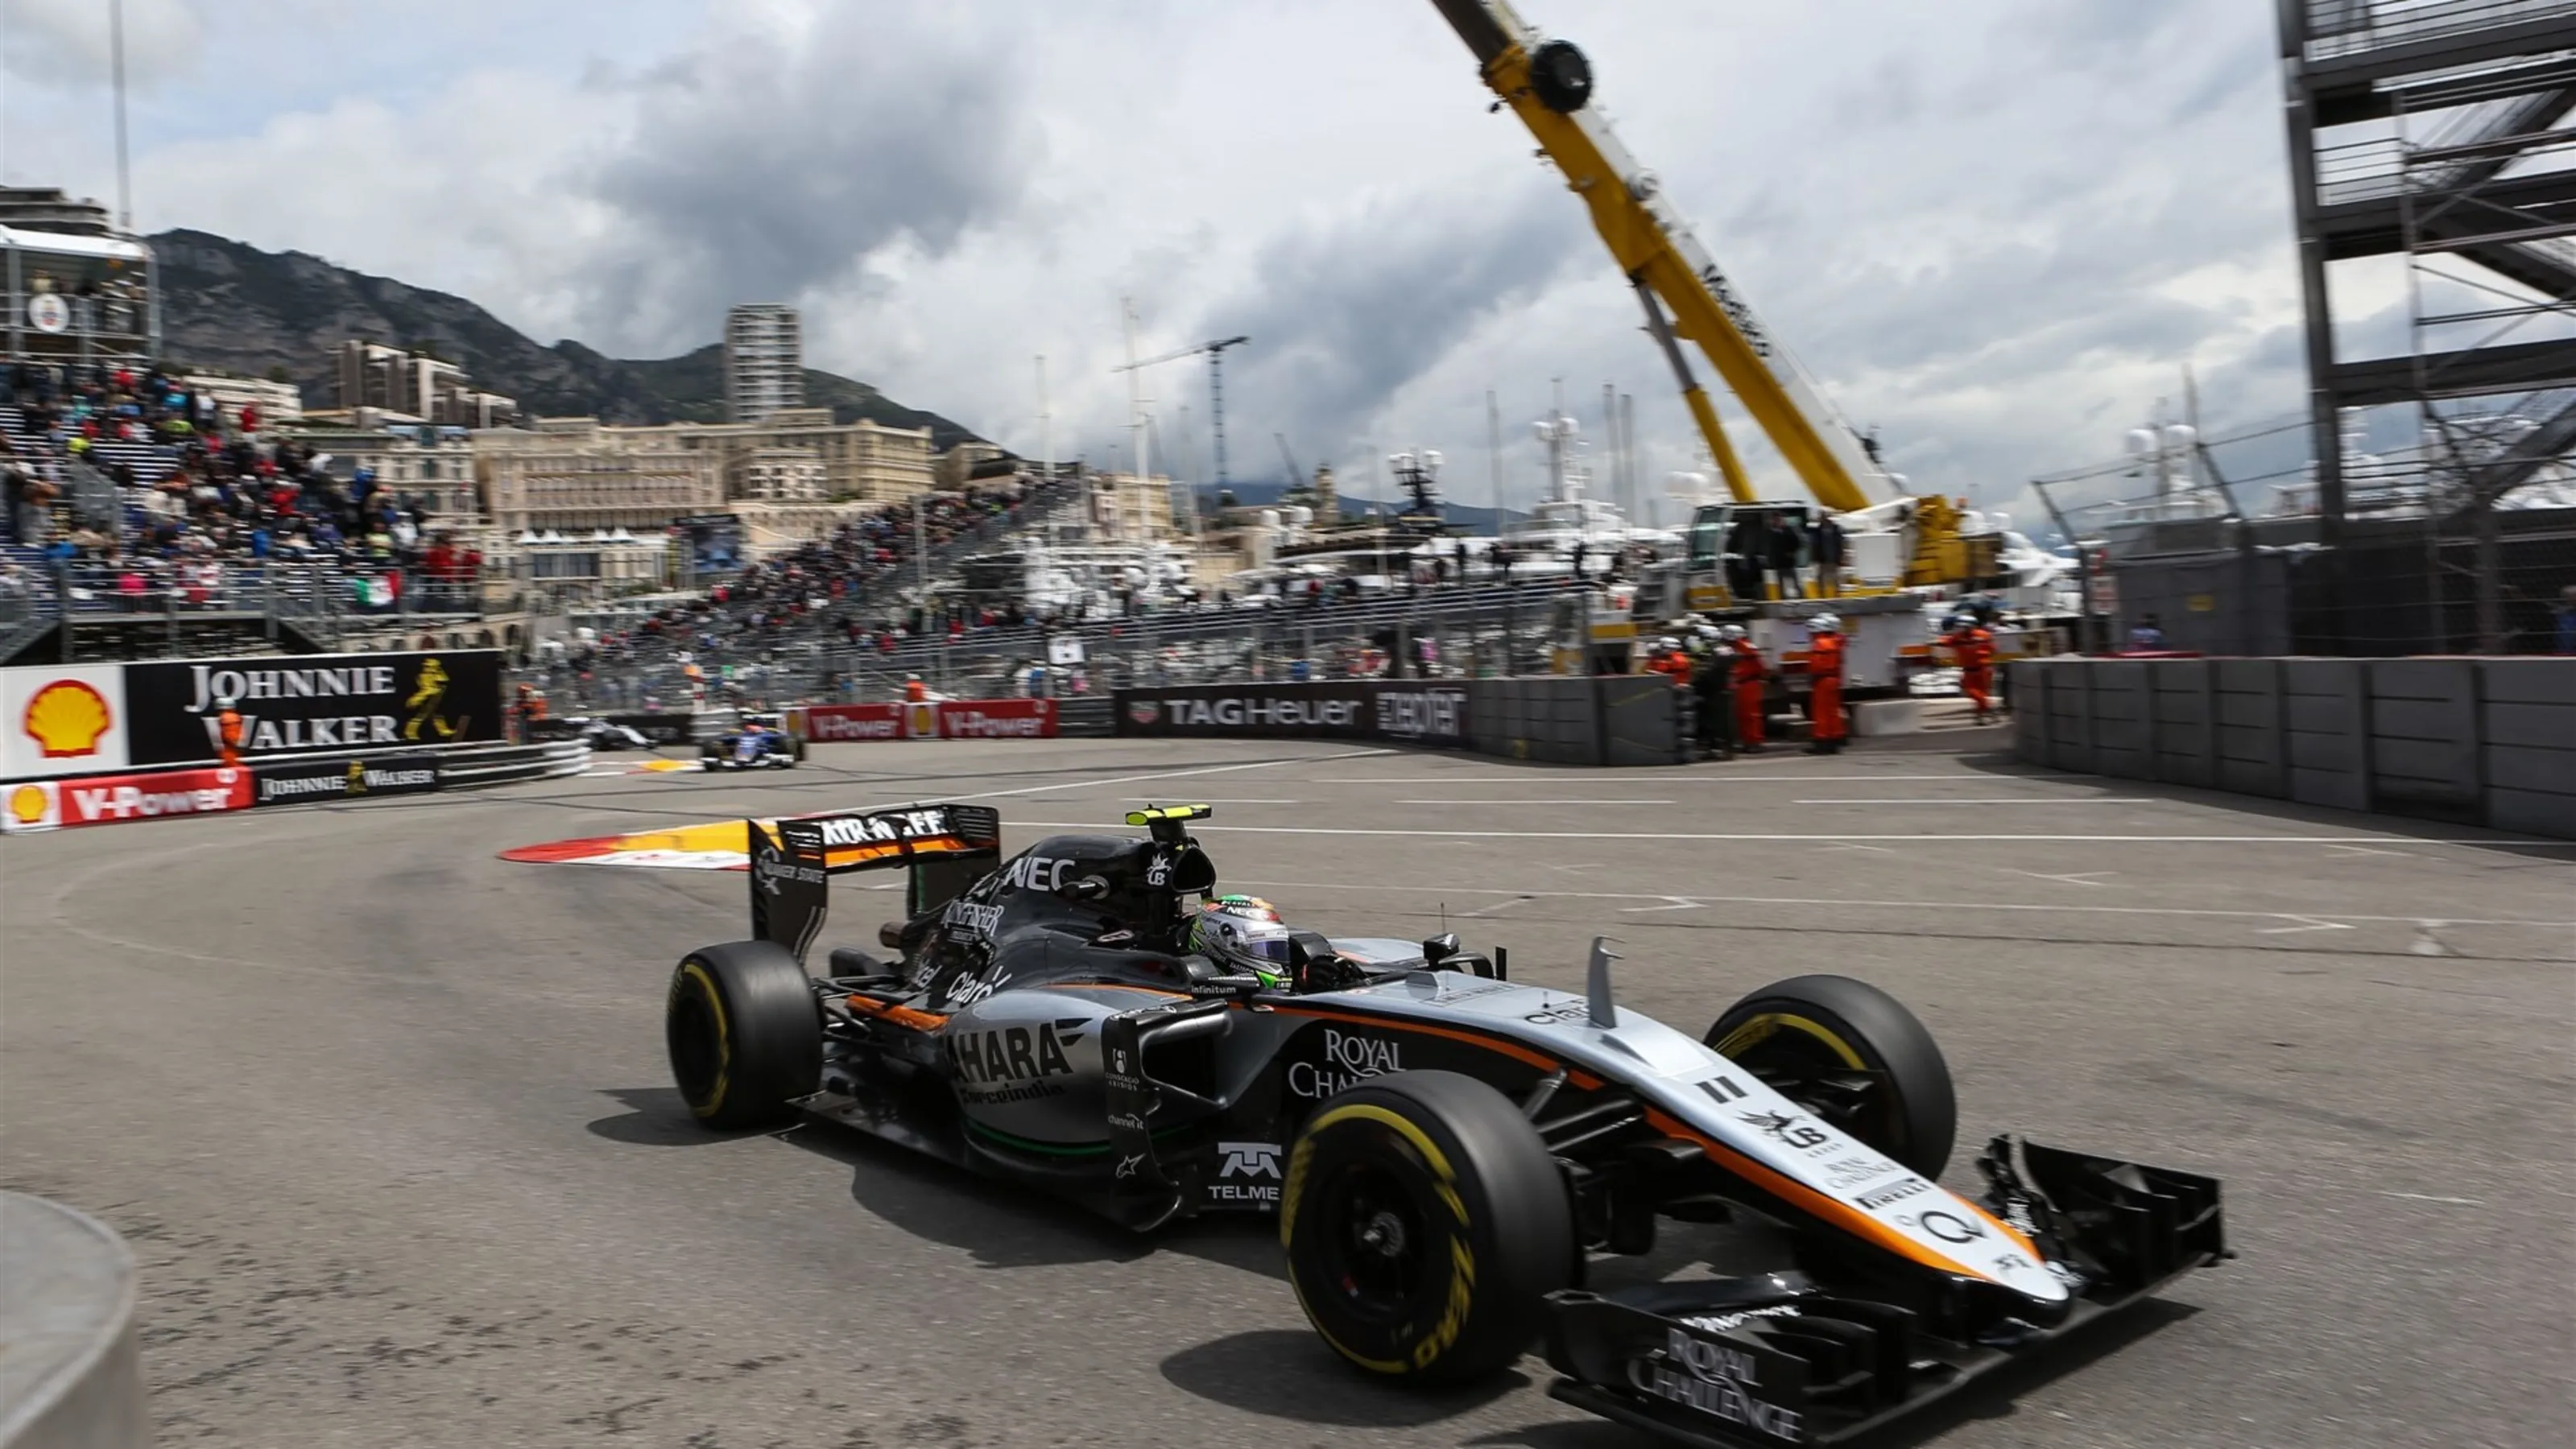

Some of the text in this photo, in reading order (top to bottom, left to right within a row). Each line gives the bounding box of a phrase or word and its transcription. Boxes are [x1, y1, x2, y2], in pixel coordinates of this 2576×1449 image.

[184, 665, 396, 712] JOHNNIE
[201, 715, 403, 751] WALKER
[71, 786, 234, 820] V-Power
[258, 775, 348, 801] JOHNNIE
[1003, 857, 1077, 891] NEC
[944, 1022, 1074, 1084] AHARA
[1324, 1028, 1408, 1077] ROYAL
[1693, 1075, 1749, 1104] 11
[1208, 1185, 1280, 1201] TELME
[1668, 1327, 1763, 1388] ROYAL
